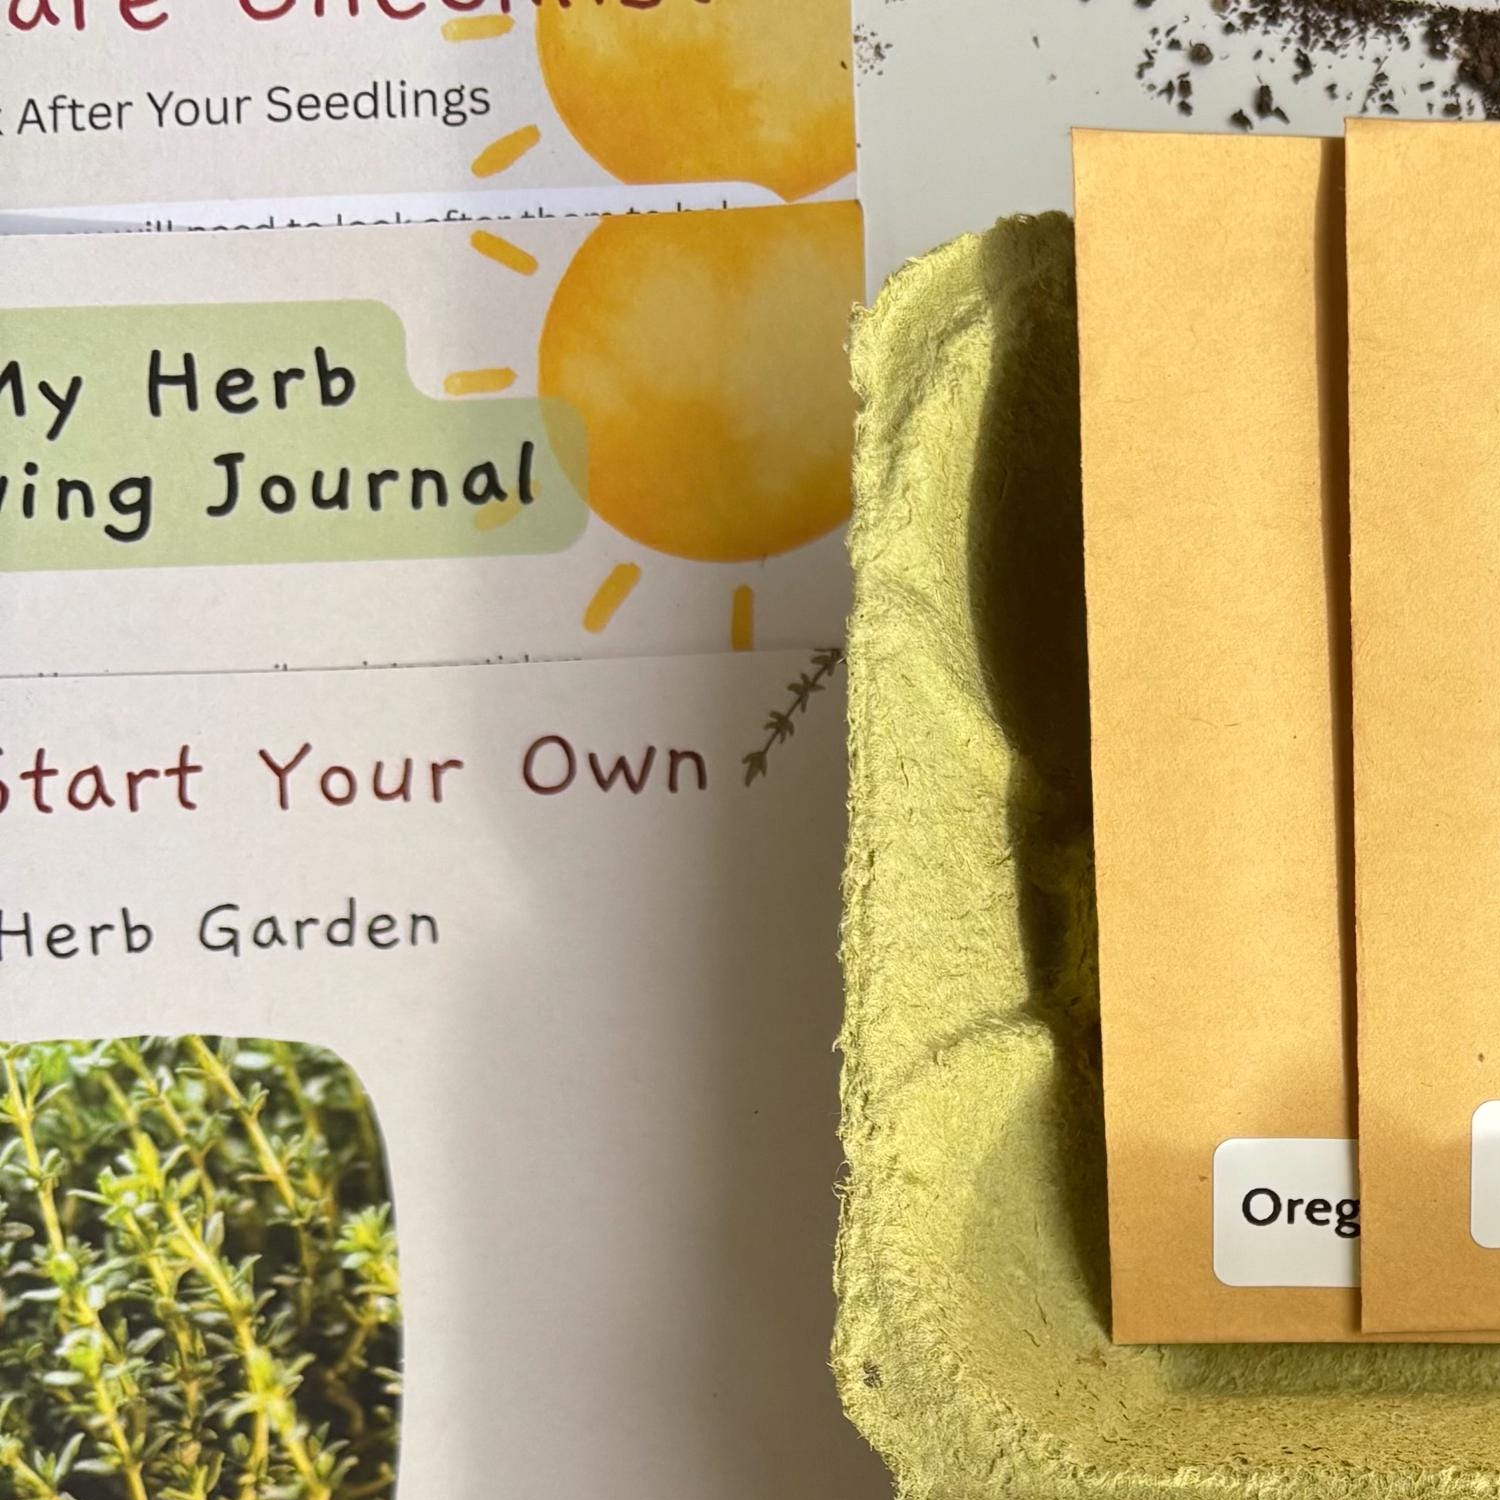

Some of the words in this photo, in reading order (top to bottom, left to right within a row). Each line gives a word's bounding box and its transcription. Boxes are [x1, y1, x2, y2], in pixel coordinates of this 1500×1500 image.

[17, 95, 133, 134] After
[147, 91, 251, 127] Your
[267, 80, 490, 126] Seedlings
[148, 346, 355, 417] Herb
[0, 462, 152, 542] ing
[206, 441, 533, 516] Journal
[0, 745, 202, 813] tart
[258, 743, 463, 810] Your
[522, 735, 706, 795] Own
[0, 907, 152, 961] Herb
[199, 897, 438, 957] Garden
